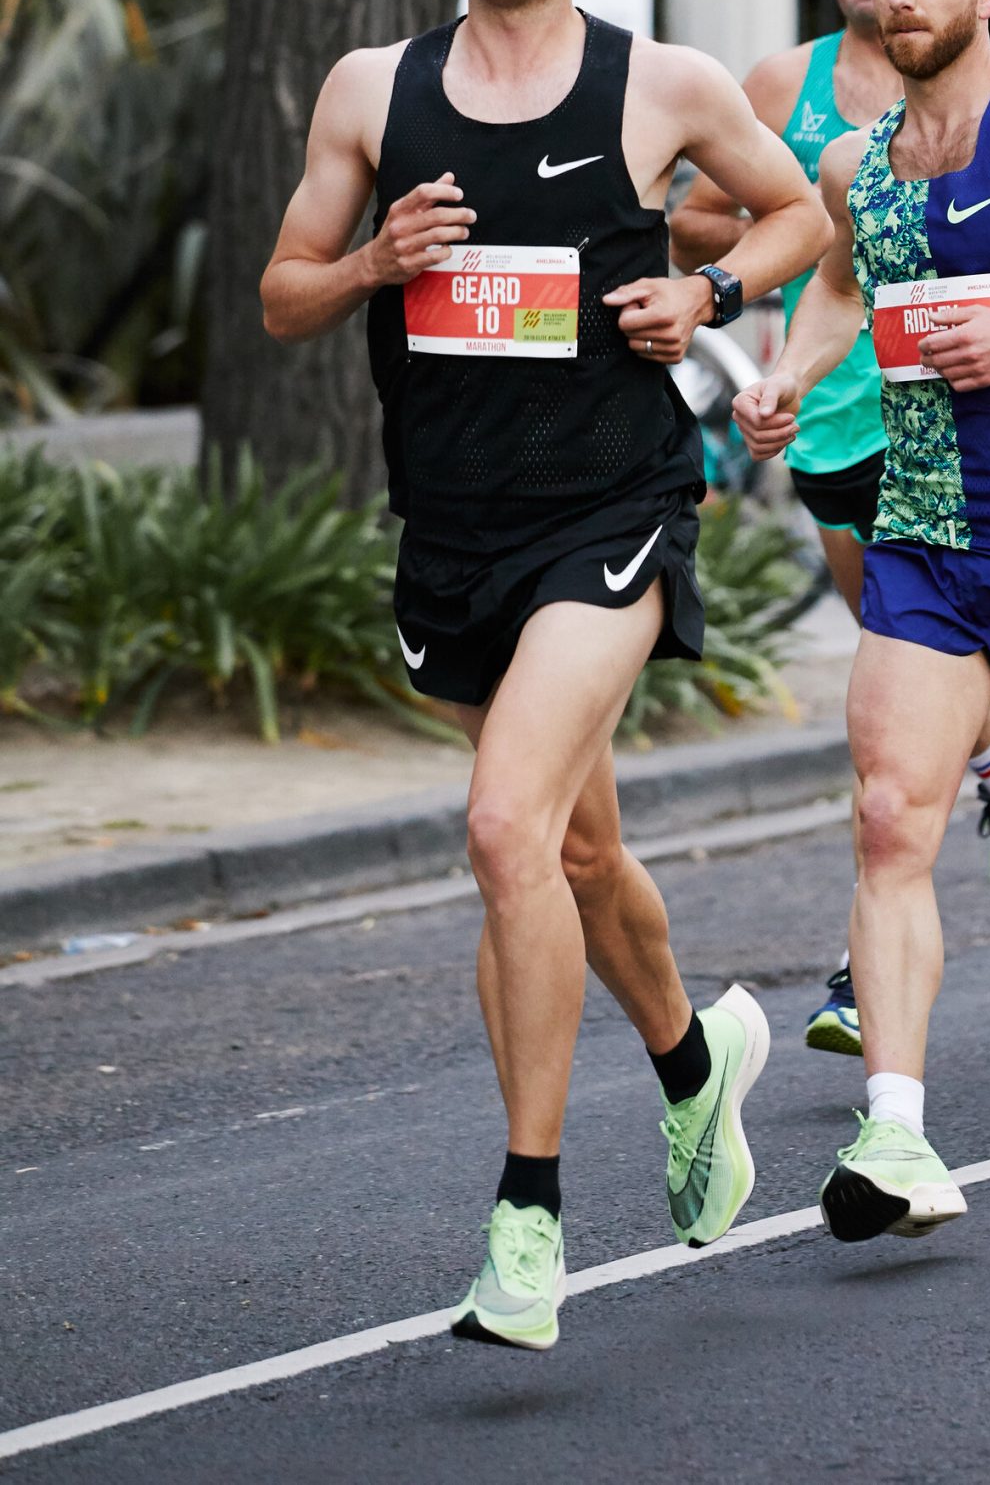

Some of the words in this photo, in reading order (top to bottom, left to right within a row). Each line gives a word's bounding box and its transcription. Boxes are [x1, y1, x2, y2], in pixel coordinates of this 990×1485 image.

[451, 275, 520, 305] GEARD
[475, 306, 500, 334] 10
[466, 341, 506, 352] MARATHON
